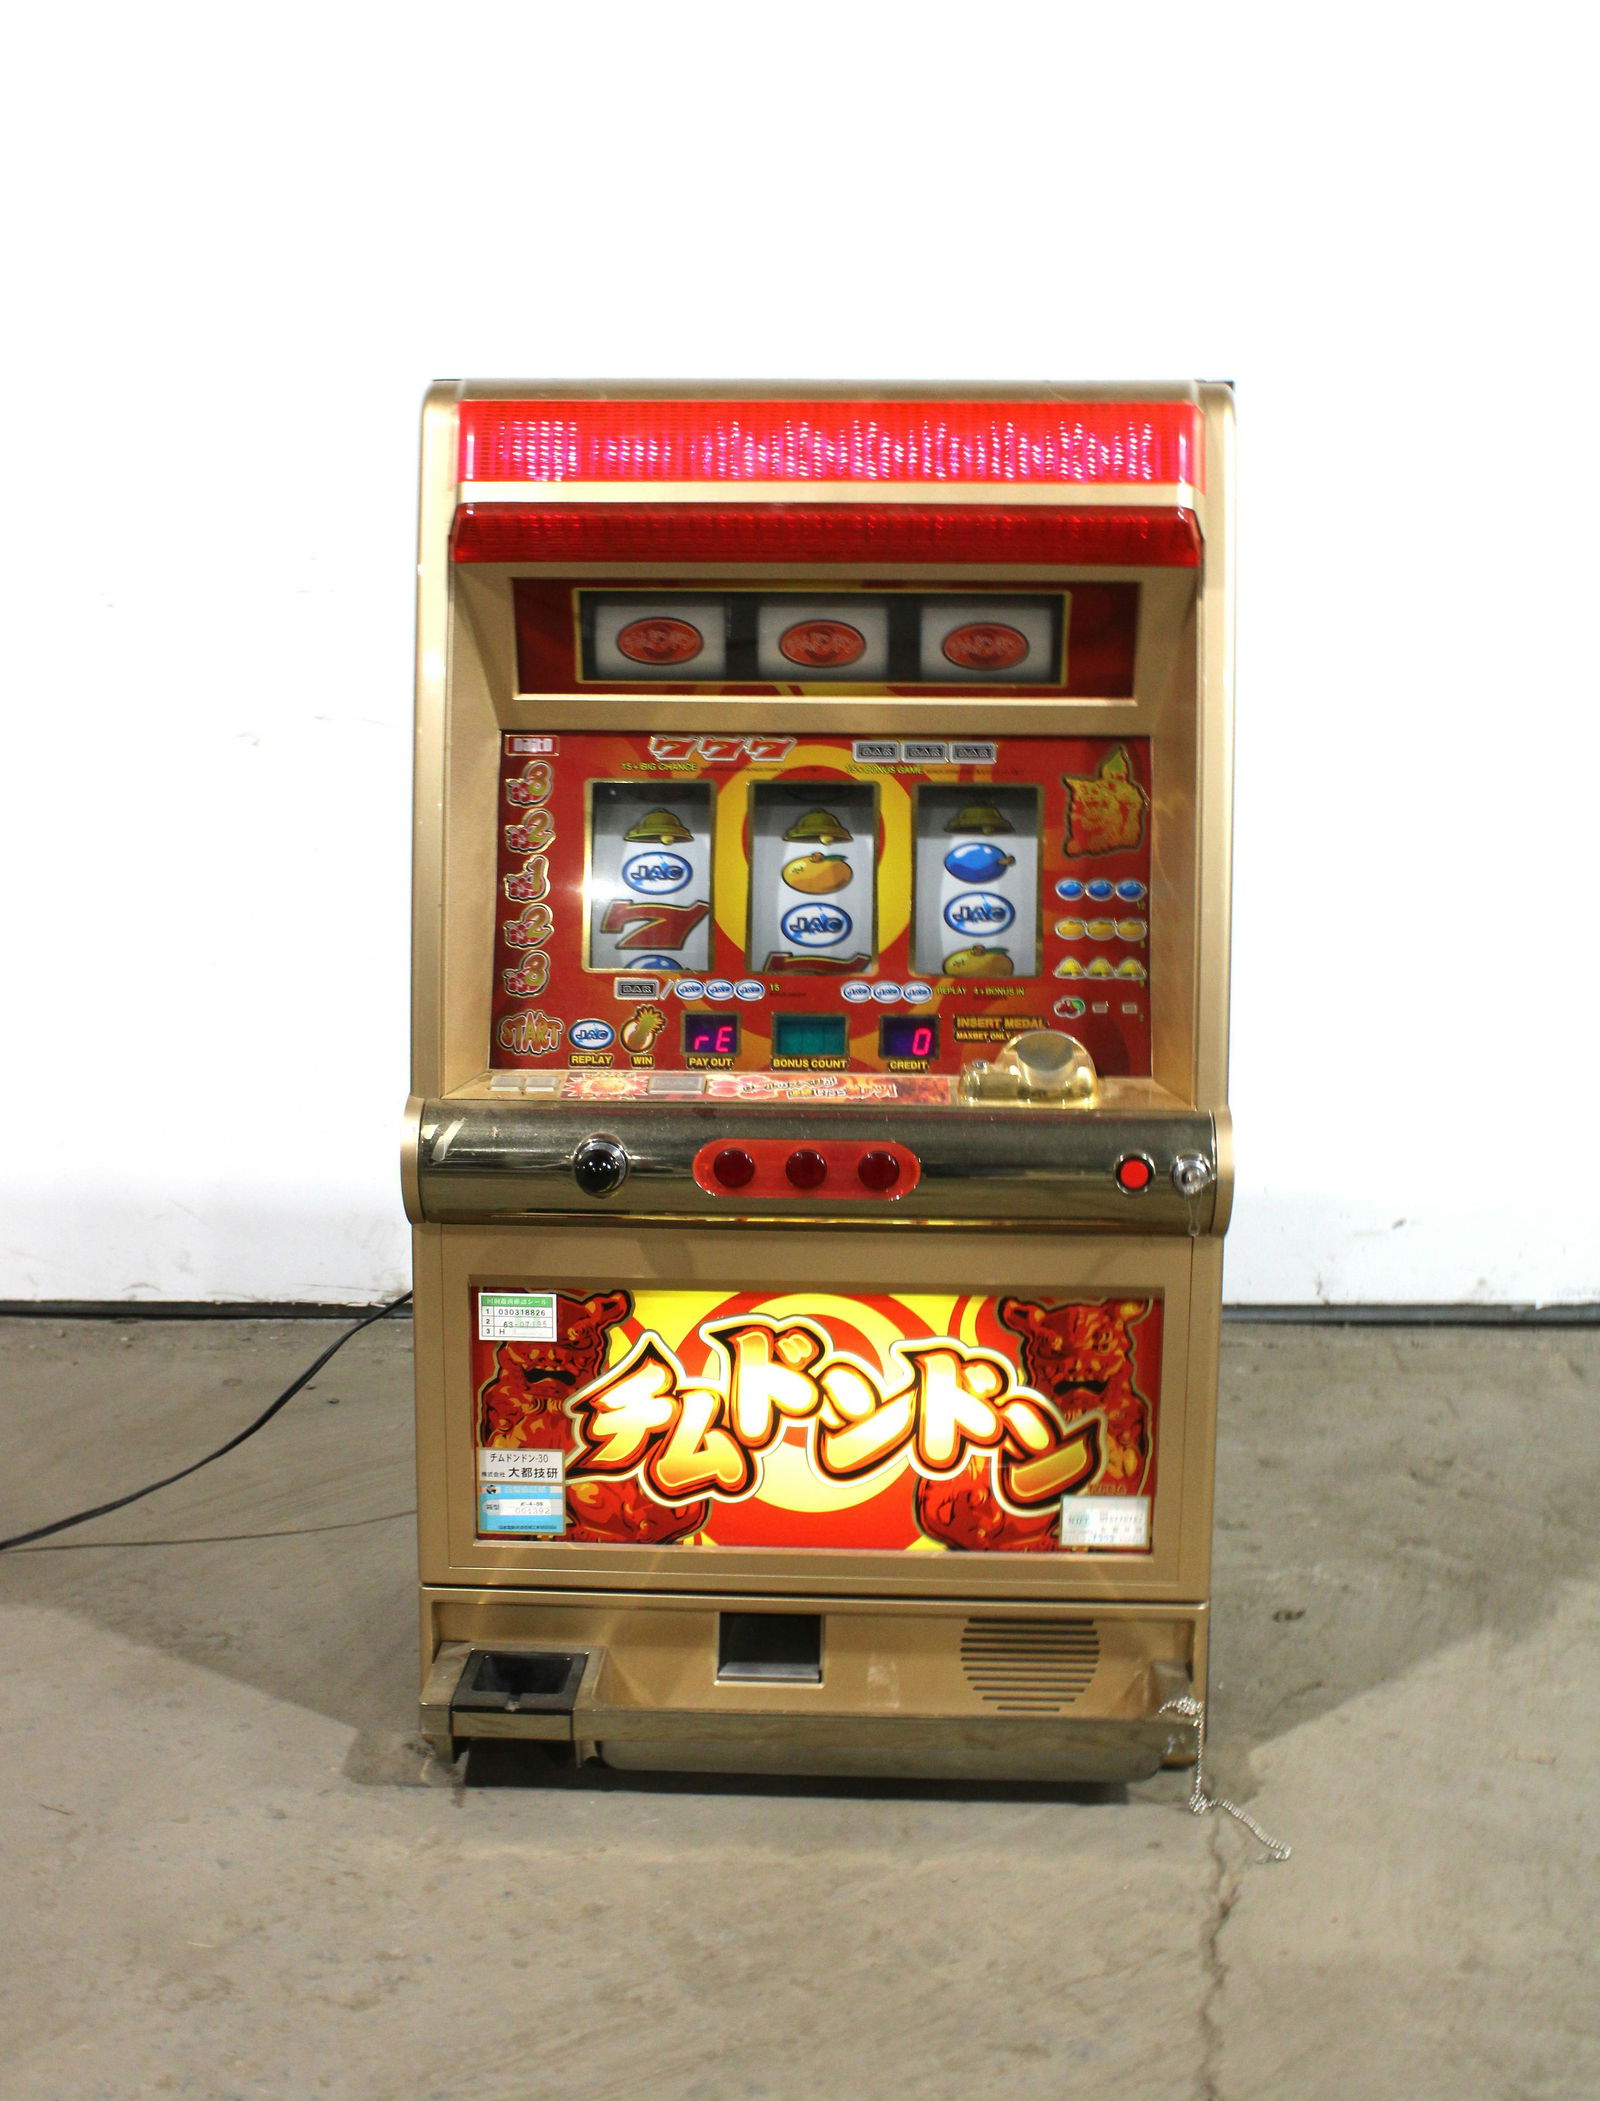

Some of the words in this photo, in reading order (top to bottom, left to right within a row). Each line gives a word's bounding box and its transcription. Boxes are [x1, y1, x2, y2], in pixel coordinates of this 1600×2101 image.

[956, 1017, 1001, 1028] INSERT
[501, 1011, 564, 1054] START
[956, 1031, 988, 1040] MAXBET
[912, 1027, 932, 1056] 0
[571, 1055, 612, 1064] REPLAY
[632, 1056, 653, 1065] WIN
[689, 1057, 708, 1066] PAY
[710, 1057, 732, 1067] OUT
[772, 1058, 809, 1068] BONUS
[810, 1059, 847, 1069] COUNT
[889, 1061, 928, 1070] CREDIT
[508, 1467, 558, 1478] 大都技研
